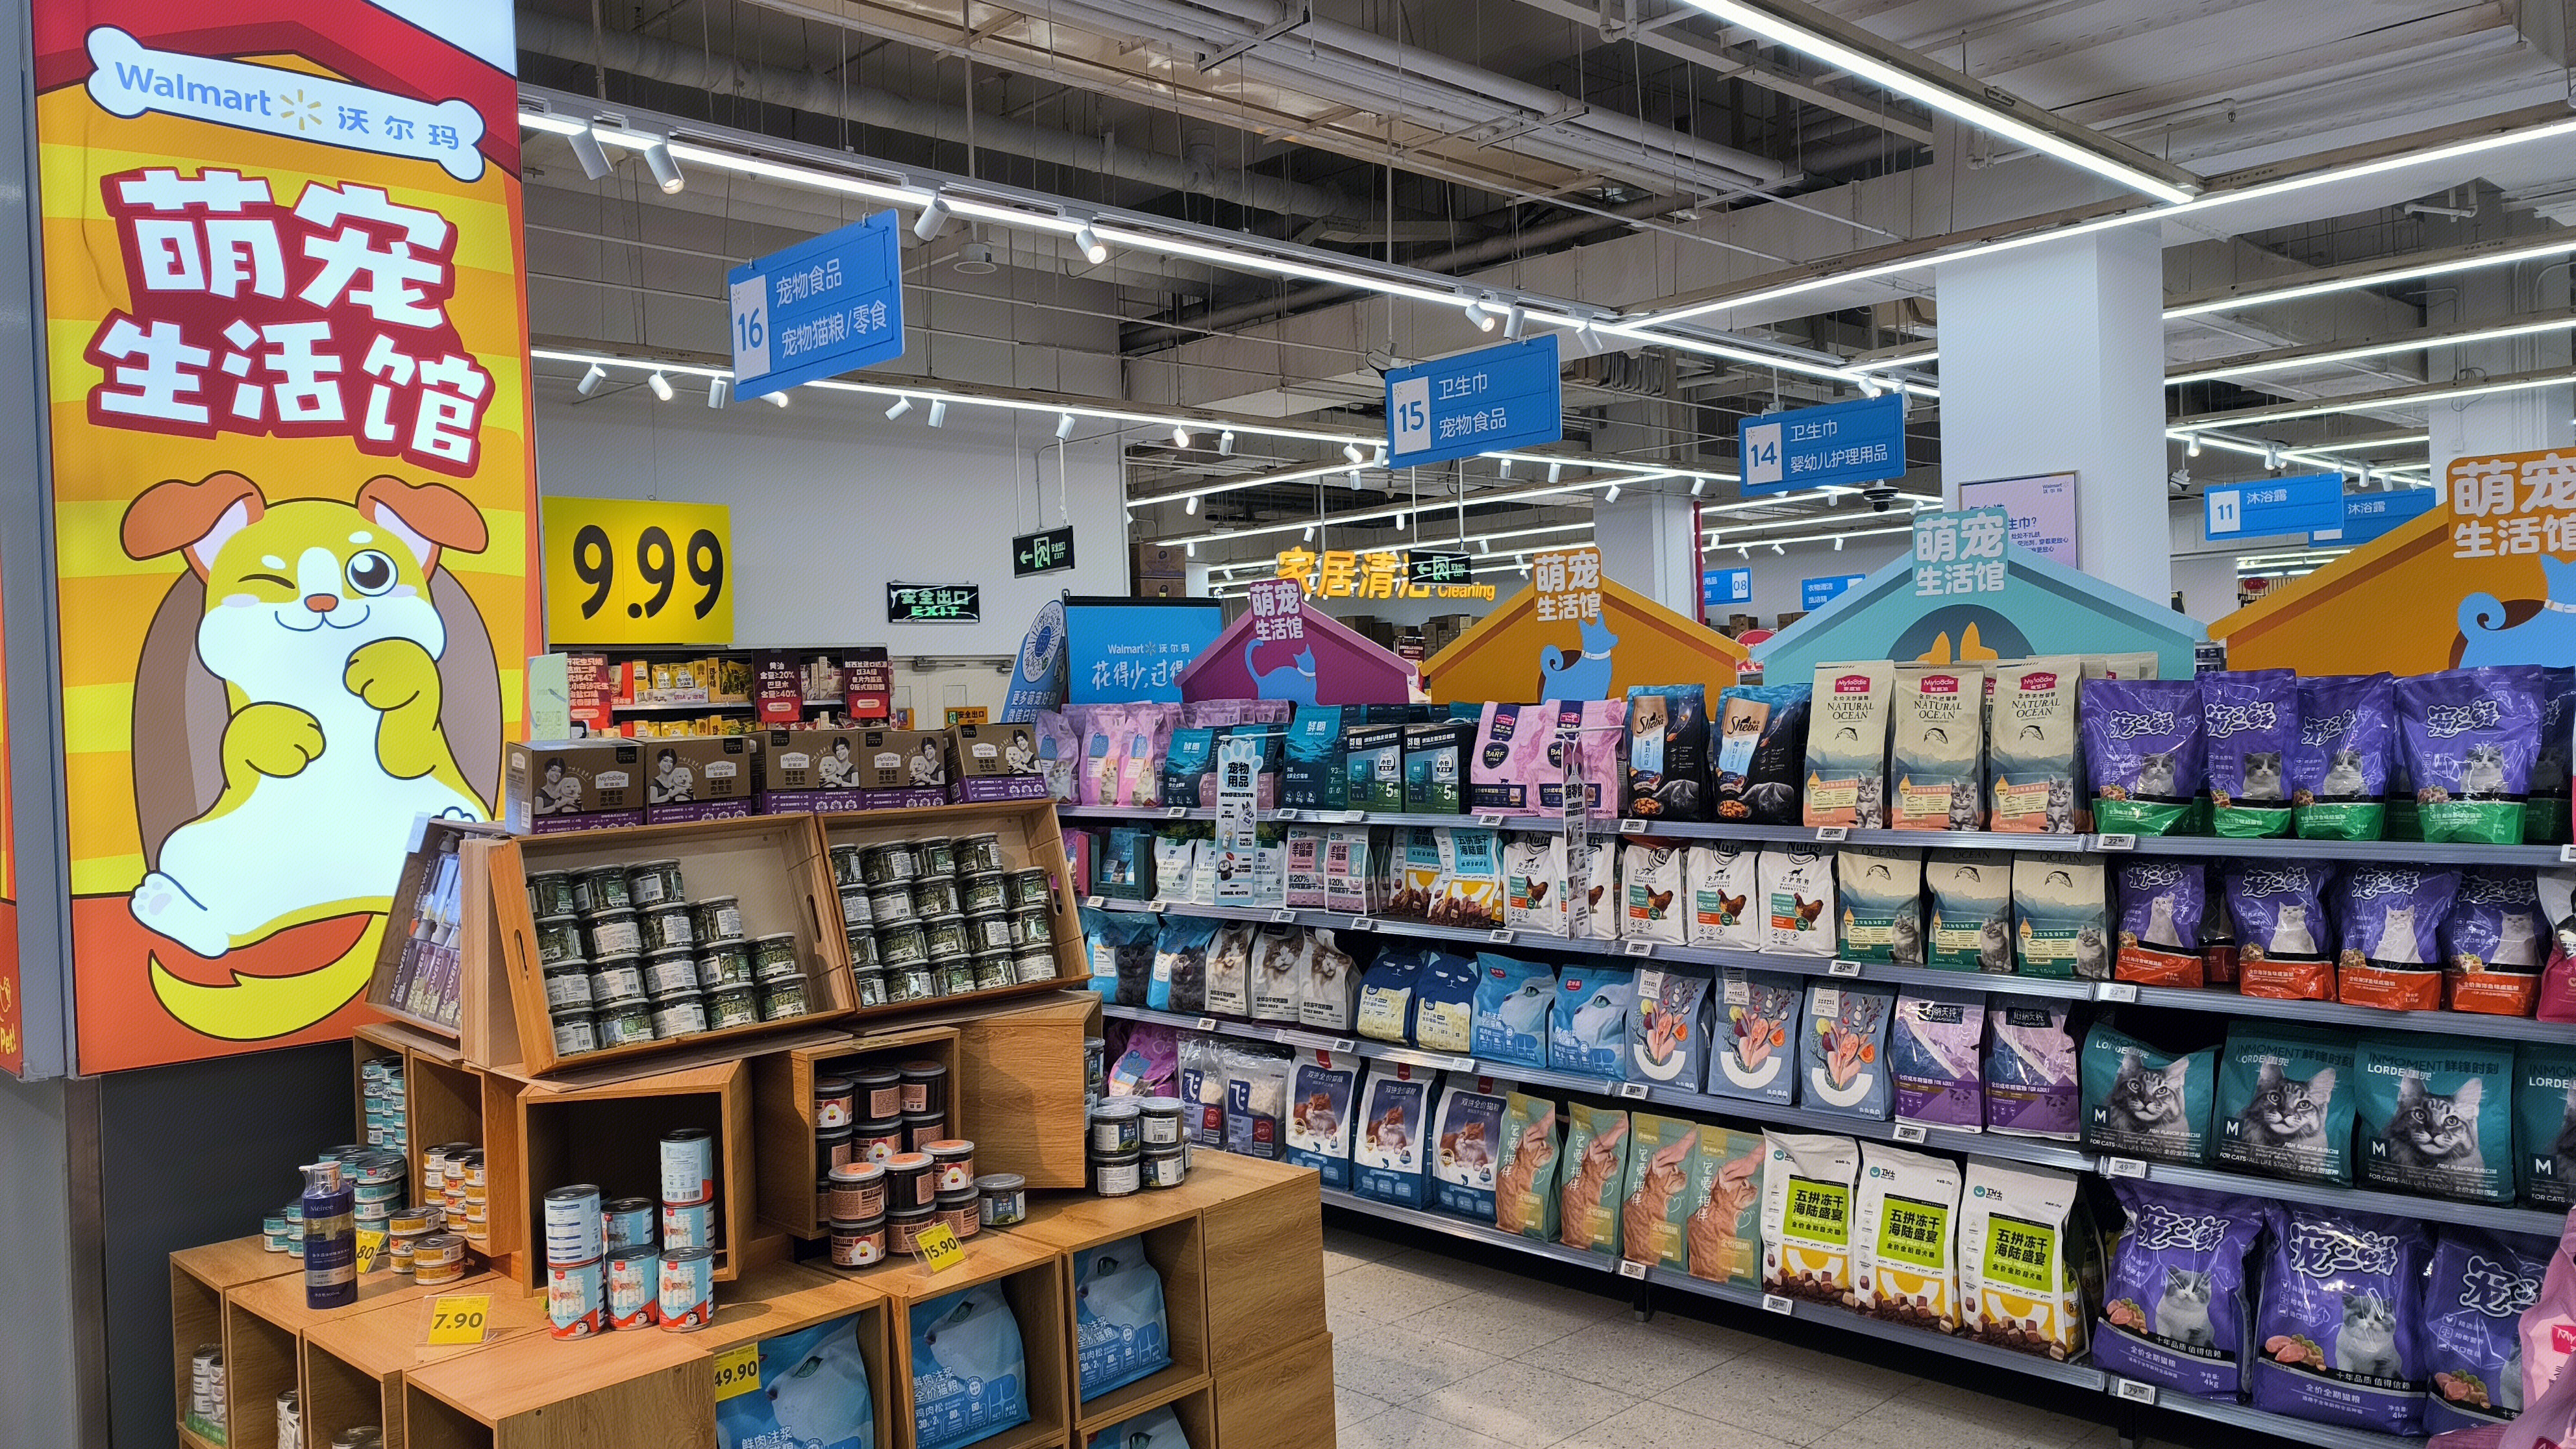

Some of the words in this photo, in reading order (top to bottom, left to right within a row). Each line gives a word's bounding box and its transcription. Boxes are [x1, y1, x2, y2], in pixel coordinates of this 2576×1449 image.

[116, 62, 271, 116] Walmart
[338, 106, 458, 150] 沃尔玛
[116, 168, 452, 330] 萌宠
[776, 258, 842, 308] 宠物食品
[738, 307, 763, 351] 16
[782, 299, 887, 358] 宠物猫粮/零食
[97, 316, 487, 465] 生活馆
[1438, 372, 1487, 401] 卫生巾
[1399, 401, 1424, 432] 15
[1439, 407, 1506, 440] 宠物食品
[1790, 420, 1838, 442] 卫生巾
[1750, 441, 1777, 467] 14
[1790, 444, 1888, 473] 婴幼儿护理用品
[2451, 453, 2576, 517] 萌宠
[2246, 489, 2287, 505] 沐浴露
[2218, 504, 2233, 520] 11
[2347, 501, 2386, 515] 沐浴露
[1915, 512, 2005, 563] 萌宠
[2453, 512, 2576, 559] 生活馆
[573, 525, 723, 620] 9.99
[1535, 551, 1600, 591] 萌宠
[1915, 559, 2005, 597] 生活馆
[1438, 582, 1495, 601] Cleaning
[1733, 580, 1747, 591] 08
[901, 590, 968, 604] 安全出口
[1250, 580, 1299, 617] 萌宠
[1537, 592, 1601, 621] 生活馆
[911, 606, 960, 616] EXIT
[1255, 617, 1304, 641] 生活馆
[1108, 644, 1144, 655] Walmart
[1159, 643, 1190, 654] 沃尔玛
[1827, 702, 1874, 712] NATURAL
[1914, 700, 1963, 712] NATURAL
[2011, 698, 2061, 709] NATURAL
[2016, 707, 2053, 718] OCEAN
[1636, 715, 1664, 734] Sheba
[1832, 710, 1868, 720] OCEAN
[1919, 710, 1955, 720] OCEAN
[1727, 719, 1759, 735] Sheba
[1485, 749, 1505, 758] BARF
[1228, 762, 1250, 775] 宠物
[1228, 774, 1249, 787] 用品
[1565, 784, 1583, 799] 猫零食
[1787, 841, 1822, 853] Nutro
[1861, 847, 1900, 858] OCEAN
[1953, 850, 1991, 860] OCEAN
[2040, 851, 2082, 863] OCEAN
[2096, 1040, 2126, 1055] LORDE
[2237, 1044, 2301, 1058] INMOMENT
[2236, 1054, 2263, 1064] LORDE
[2369, 1052, 2444, 1071] INMOMENT
[2444, 1059, 2499, 1074] 鲜锋时刻
[2367, 1063, 2404, 1077] LORDE
[2529, 1076, 2569, 1089] LORDE
[2095, 1109, 2106, 1123] M
[2227, 1121, 2239, 1136] M
[1501, 1122, 1520, 1177] 宠爱相伴
[2140, 1146, 2162, 1155] STAGES
[2372, 1141, 2386, 1157] M
[1568, 1133, 1585, 1191] 宠爱相伴
[2273, 1161, 2297, 1170] STAGES
[2536, 1158, 2551, 1175] M
[1631, 1146, 1648, 1206] 宠爱相伴
[1696, 1159, 1714, 1222] 宠爱相伴
[2427, 1182, 2453, 1191] STAGES
[1796, 1189, 1844, 1209] 五拼冻干
[1793, 1202, 1843, 1222] 海陆盛宴
[1890, 1208, 1940, 1229] 五拼冻干
[1888, 1223, 1938, 1244] 海陆盛宴
[1996, 1228, 2048, 1251] 五拼冻干
[924, 1237, 957, 1261] 15.90
[1994, 1243, 2046, 1266] 海陆盛宴
[2027, 1264, 2044, 1272] FEAST
[434, 1311, 483, 1330] 7.90
[1078, 1327, 1115, 1347] 全价猫粮
[715, 1360, 758, 1387] 49.90
[2337, 1371, 2372, 1386] 十年品质
[2374, 1378, 2410, 1391] 值得信赖
[915, 1380, 960, 1404] 全价猫粮
[2305, 1383, 2360, 1404] 全价全期猫粮
[915, 1403, 944, 1418] 鸡肉松
[741, 1426, 793, 1449] 鲜肉注浆
